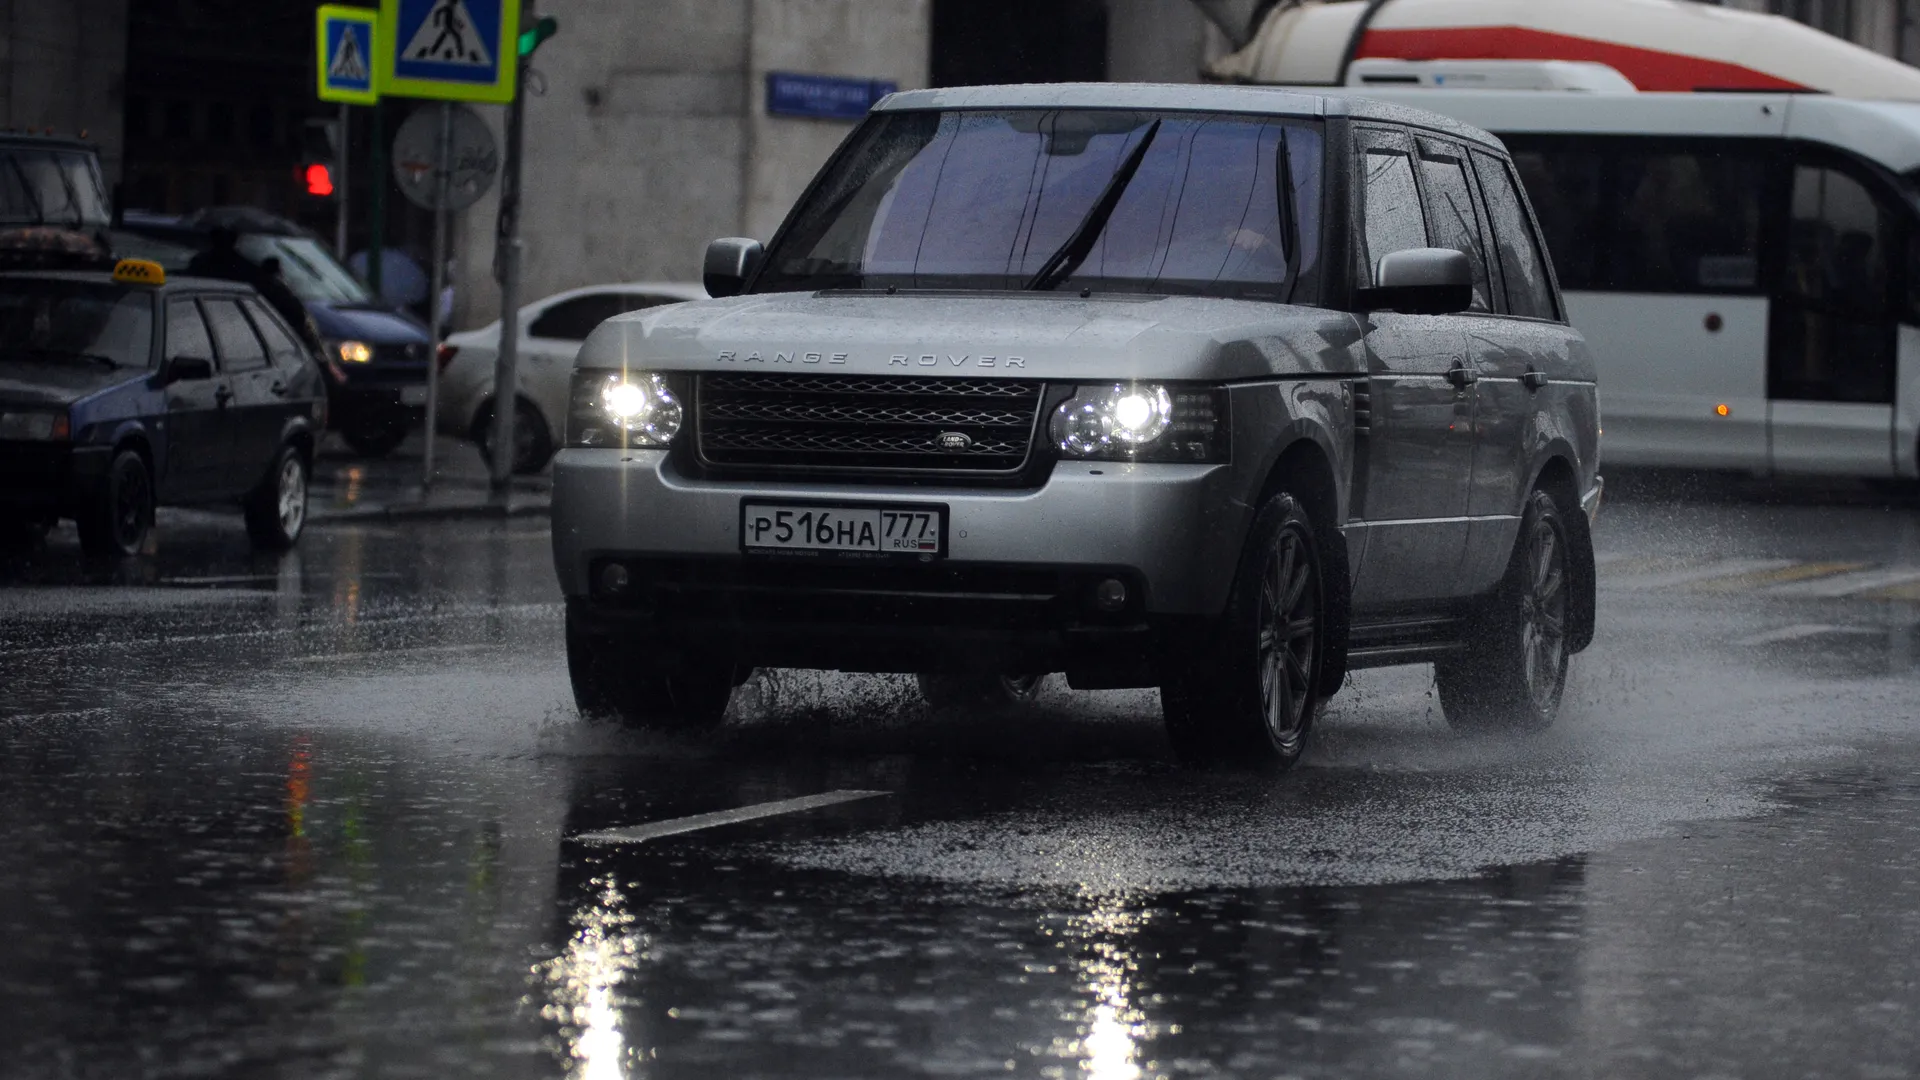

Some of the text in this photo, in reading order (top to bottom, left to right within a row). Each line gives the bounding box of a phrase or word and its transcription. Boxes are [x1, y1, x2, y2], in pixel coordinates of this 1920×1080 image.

[717, 349, 1026, 369] RANGE ROVER
[754, 511, 931, 546] Р516НА 777
[893, 539, 918, 549] RUS
